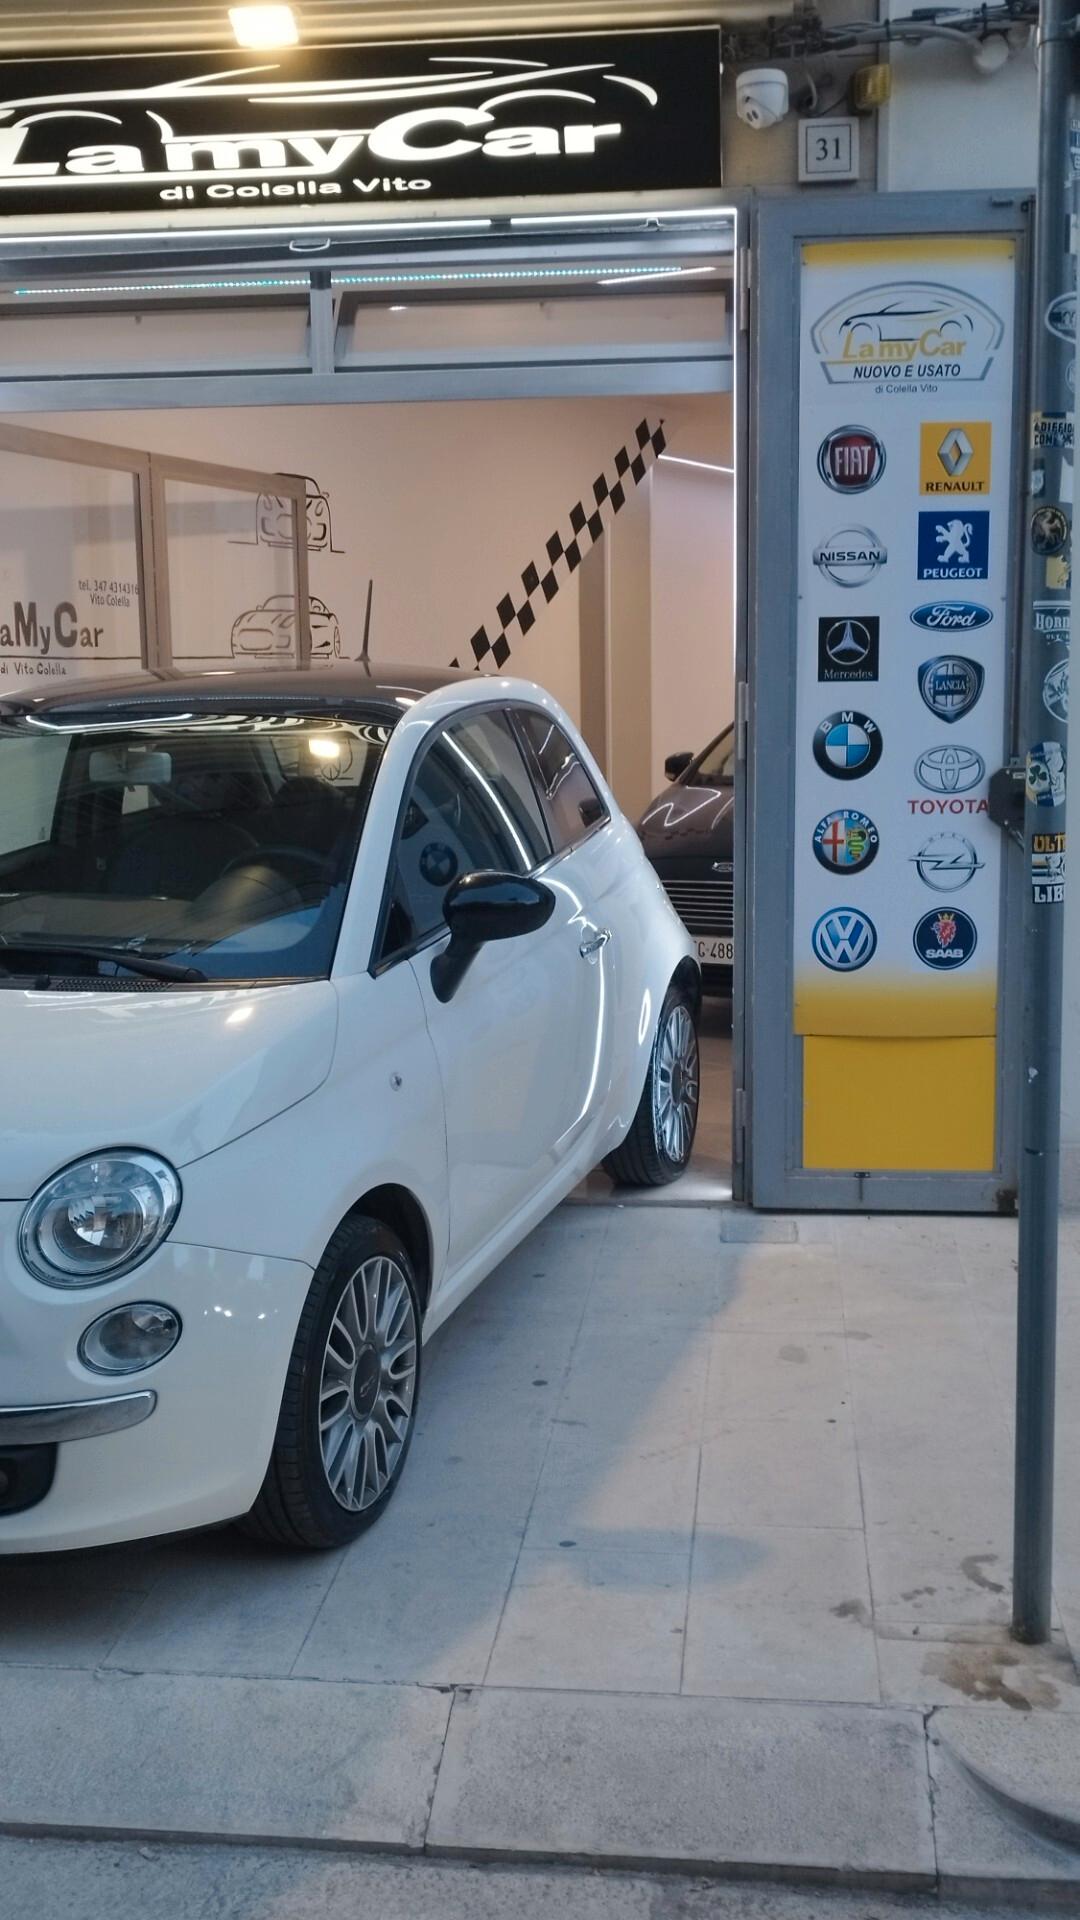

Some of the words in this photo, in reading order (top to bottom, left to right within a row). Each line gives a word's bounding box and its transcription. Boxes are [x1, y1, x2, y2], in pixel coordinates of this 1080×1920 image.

[815, 137, 841, 161] 31
[159, 186, 194, 200] di
[207, 180, 342, 197] Colella
[353, 175, 432, 193] Vito
[853, 365, 901, 379] NUOVO
[904, 365, 914, 378] E
[917, 364, 961, 377] USATO
[875, 385, 884, 394] di
[885, 384, 918, 394] Colella
[920, 383, 938, 393] Vito
[834, 445, 871, 476] FIAT
[925, 481, 985, 493] RENAULT
[819, 550, 881, 562] NISSAN
[922, 567, 984, 579] PEUGEOT
[94, 580, 107, 591] 347
[90, 593, 105, 605] Vito
[106, 594, 131, 607] Colella
[926, 605, 976, 626] Ford
[14, 662, 34, 675] Vito
[824, 669, 874, 680] Mercedes
[935, 680, 966, 690] LANCIA
[820, 711, 877, 734] BMW
[907, 799, 989, 815] TOYOTA
[814, 817, 832, 844] ALFA
[843, 811, 878, 844] ROMEO
[925, 948, 964, 959] SAAB
